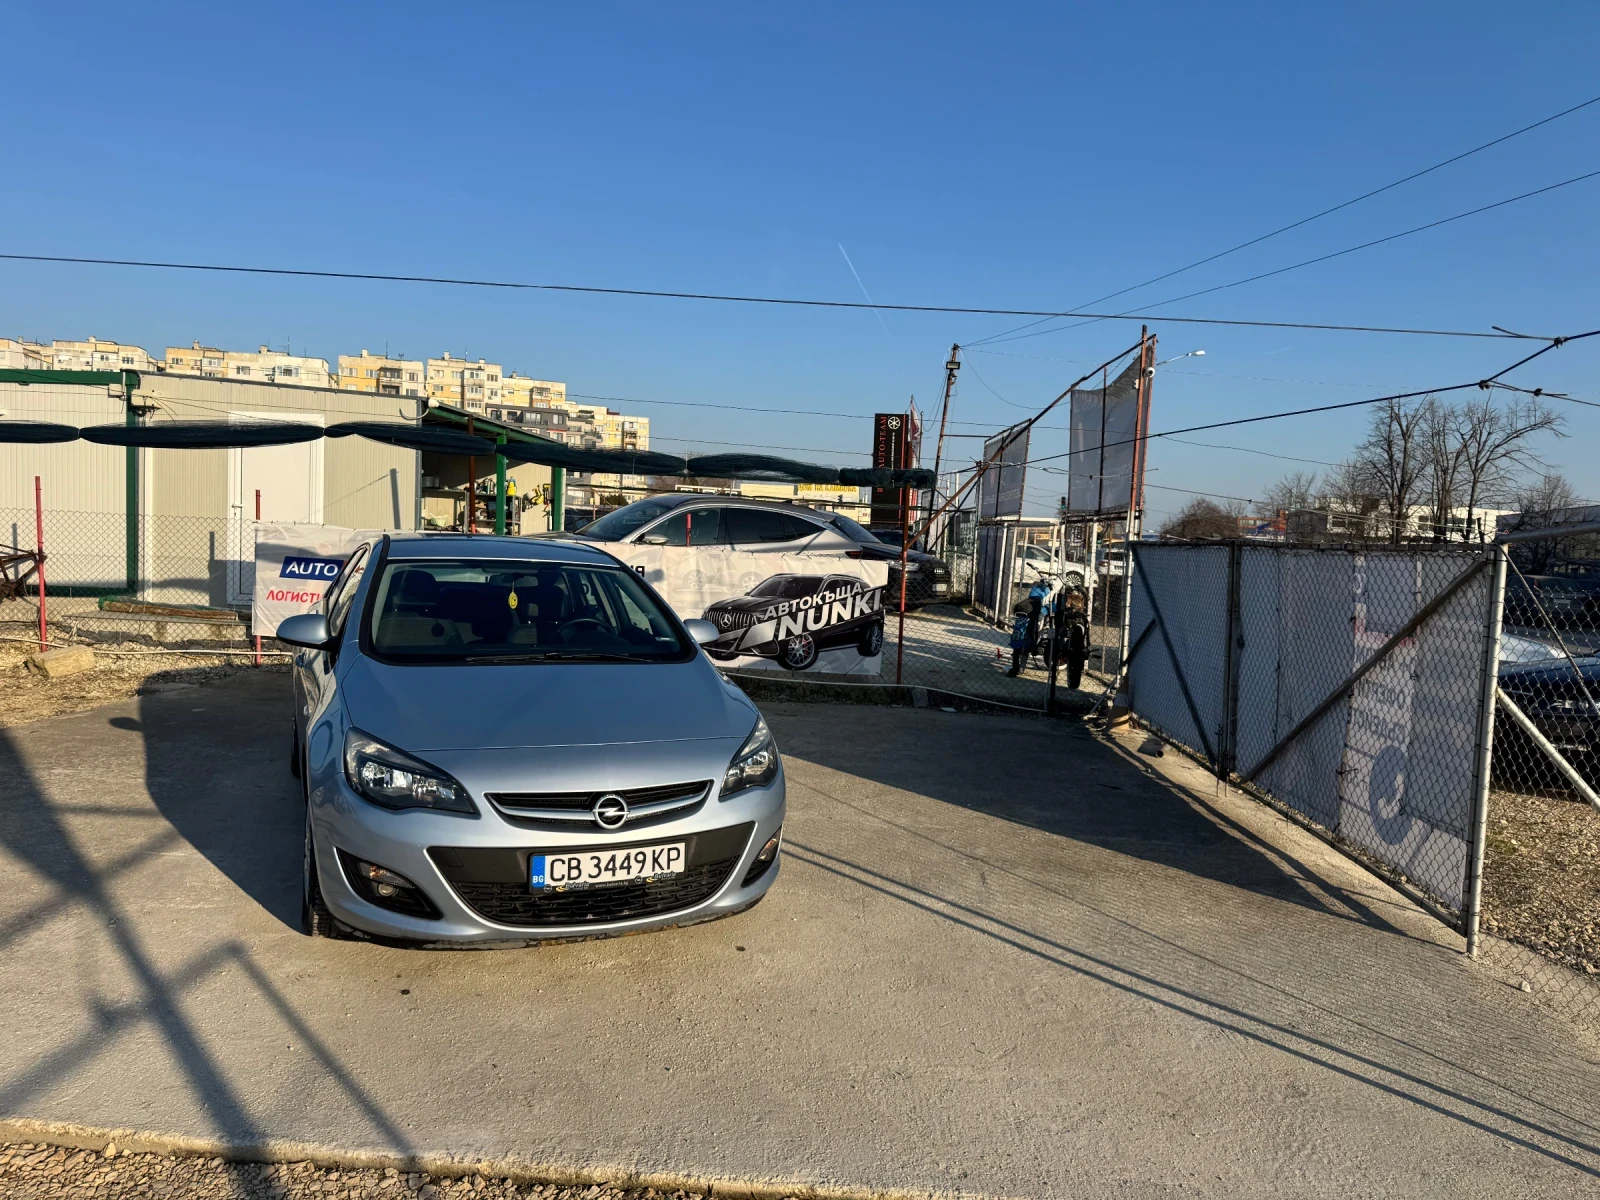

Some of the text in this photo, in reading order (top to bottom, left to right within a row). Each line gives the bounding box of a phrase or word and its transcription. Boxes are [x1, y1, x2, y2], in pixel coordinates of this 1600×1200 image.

[286, 561, 338, 576] AUTO
[763, 581, 862, 621] АВТОКЪЩА
[777, 588, 882, 641] NUNKI
[532, 847, 681, 884] BG CB 3449 KP
